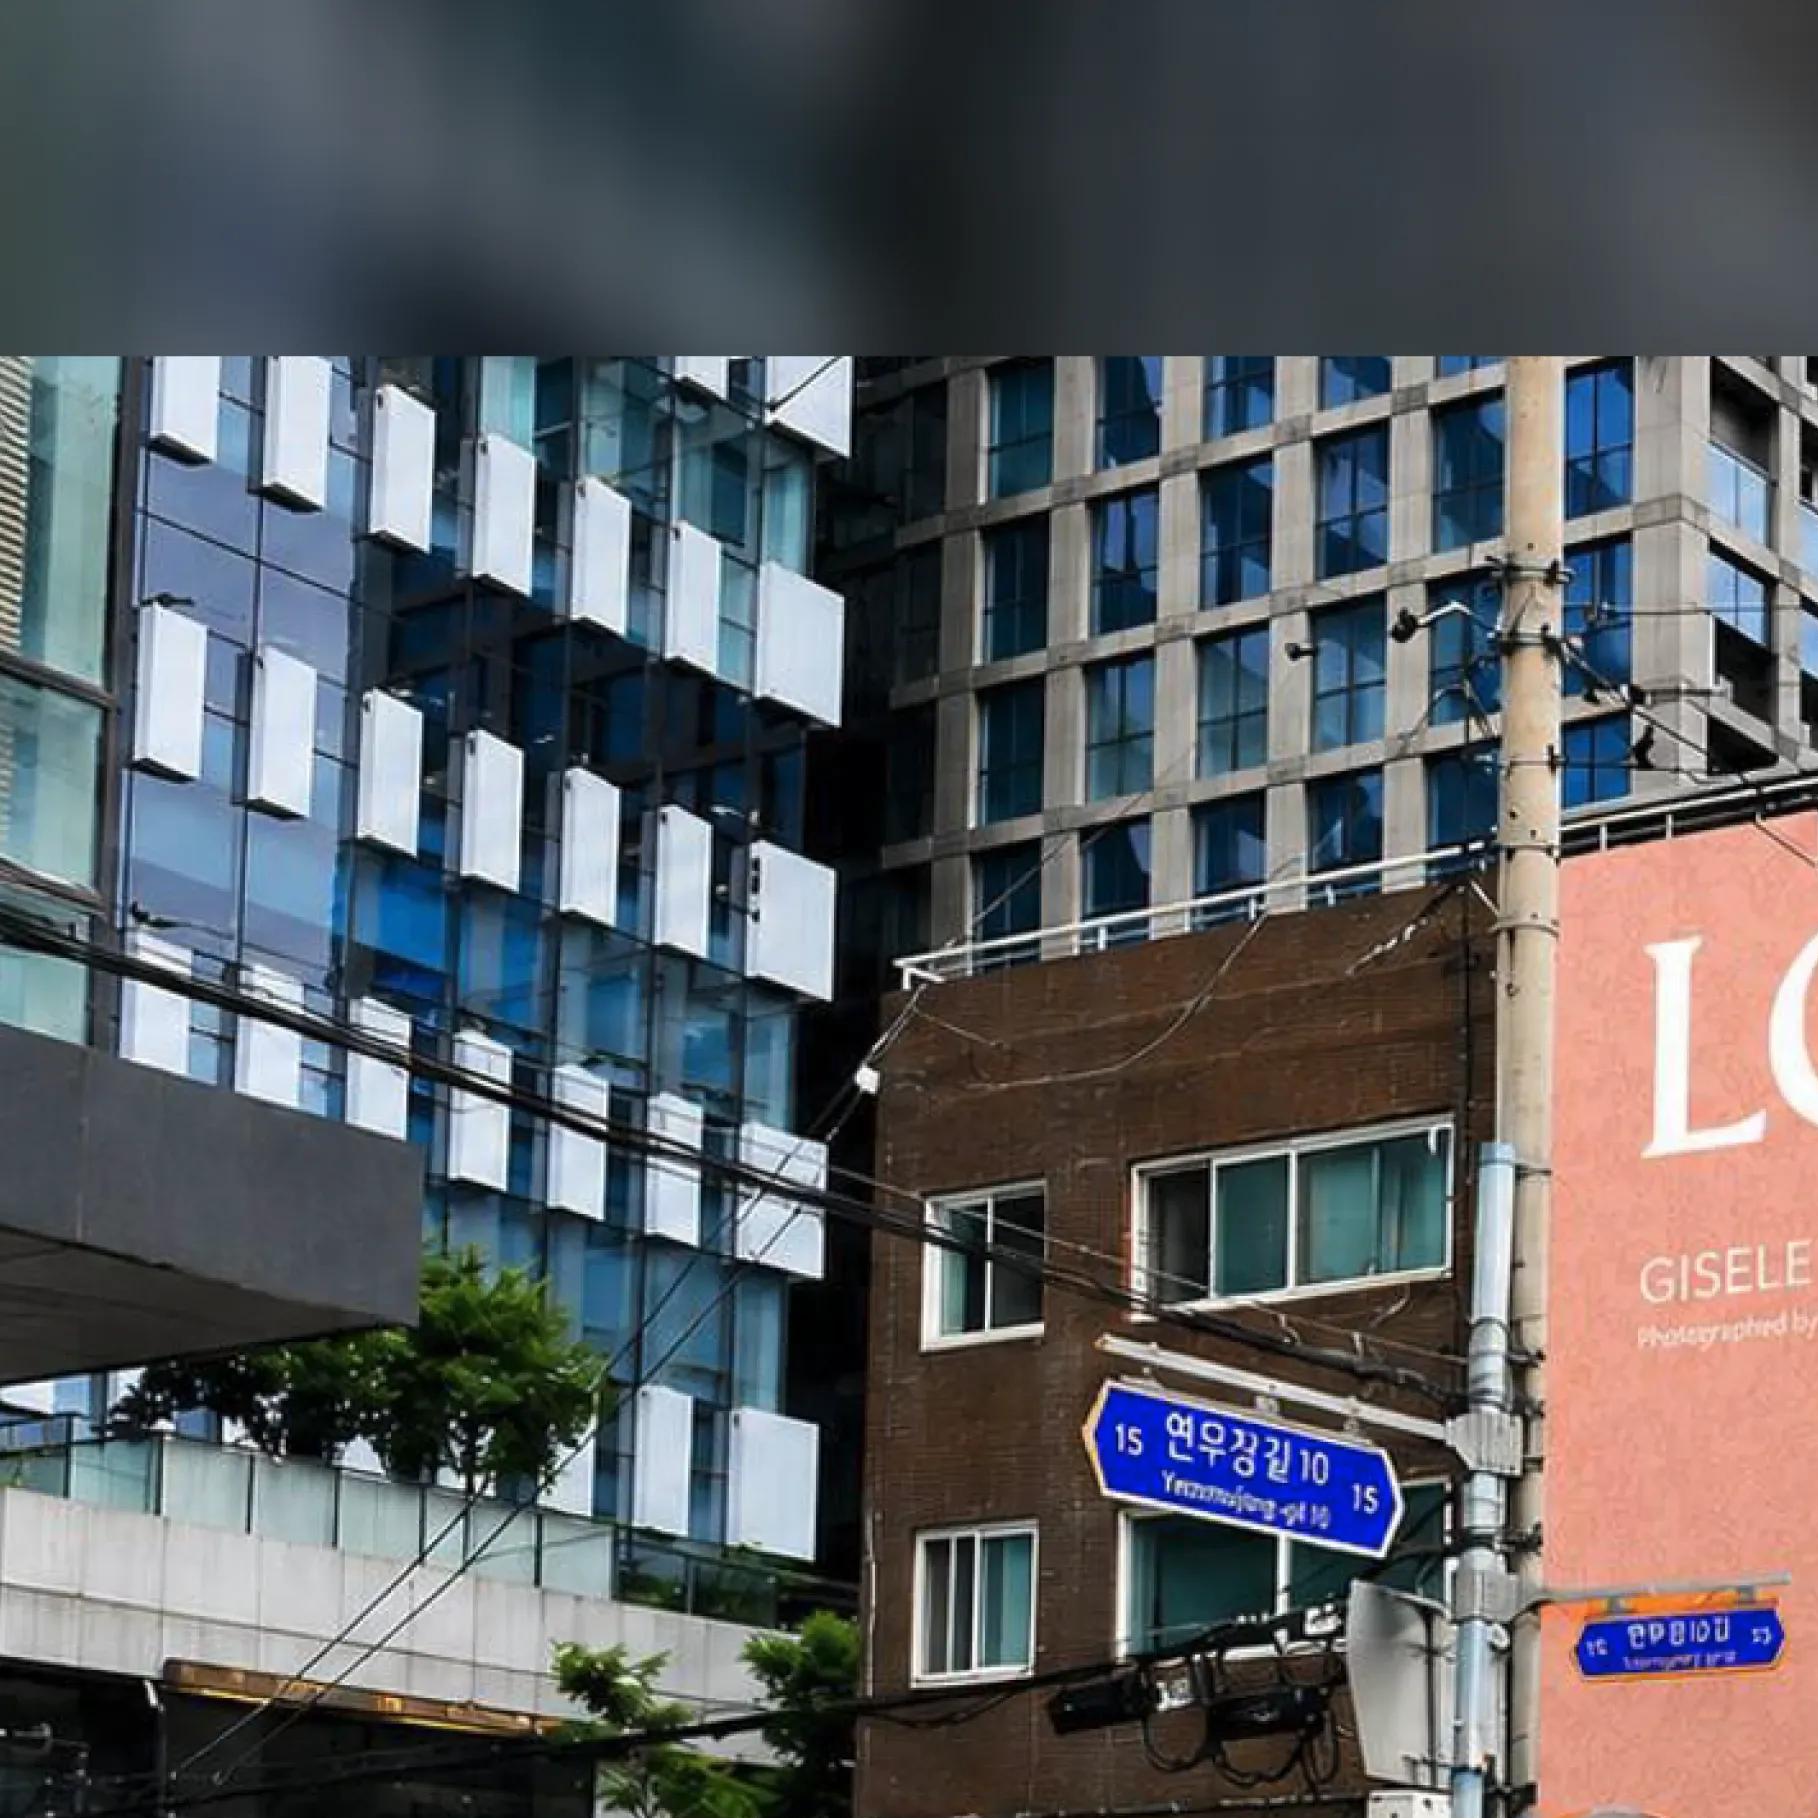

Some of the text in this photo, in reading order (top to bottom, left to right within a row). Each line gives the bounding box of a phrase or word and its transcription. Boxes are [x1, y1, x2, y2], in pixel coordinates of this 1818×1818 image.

[1639, 1238, 1813, 1304] GISELE
[1115, 1424, 1143, 1456] 15
[1300, 1449, 1329, 1485] 10
[1352, 1484, 1379, 1514] 15
